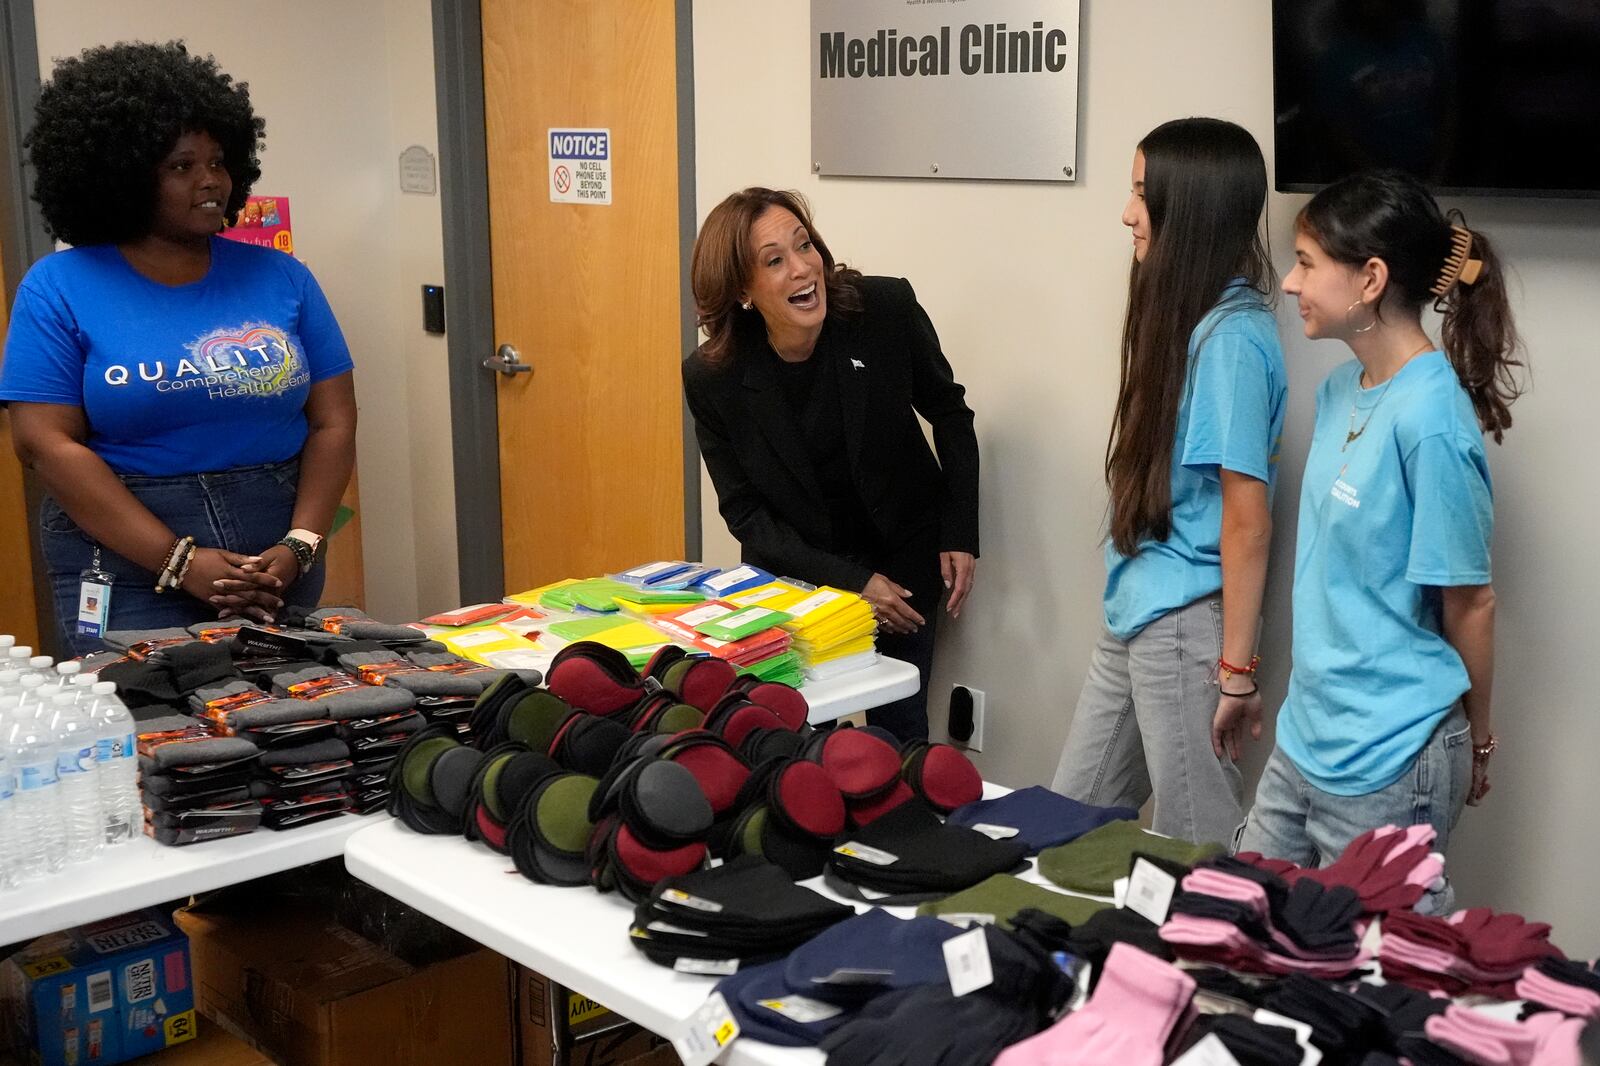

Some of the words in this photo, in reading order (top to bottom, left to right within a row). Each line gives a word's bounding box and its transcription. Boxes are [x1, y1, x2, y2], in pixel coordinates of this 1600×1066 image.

[820, 26, 950, 78] Medical
[960, 21, 1067, 76] Clinic
[553, 135, 606, 156] NOTICE
[576, 171, 594, 180] PHONE
[595, 172, 606, 180] USE
[580, 162, 588, 170] NO
[589, 162, 602, 170] CELL
[577, 190, 589, 199] THIS
[590, 191, 606, 199] POINT
[581, 181, 602, 189] BEYOND
[278, 234, 289, 246] 18
[104, 340, 294, 385] QUALITY
[156, 360, 299, 392] Comprehensive
[208, 380, 273, 399] Health
[276, 371, 311, 390] Cente
[129, 965, 144, 1000] GRAIN
[142, 962, 152, 997] NUTRI
[173, 1018, 188, 1038] 64
